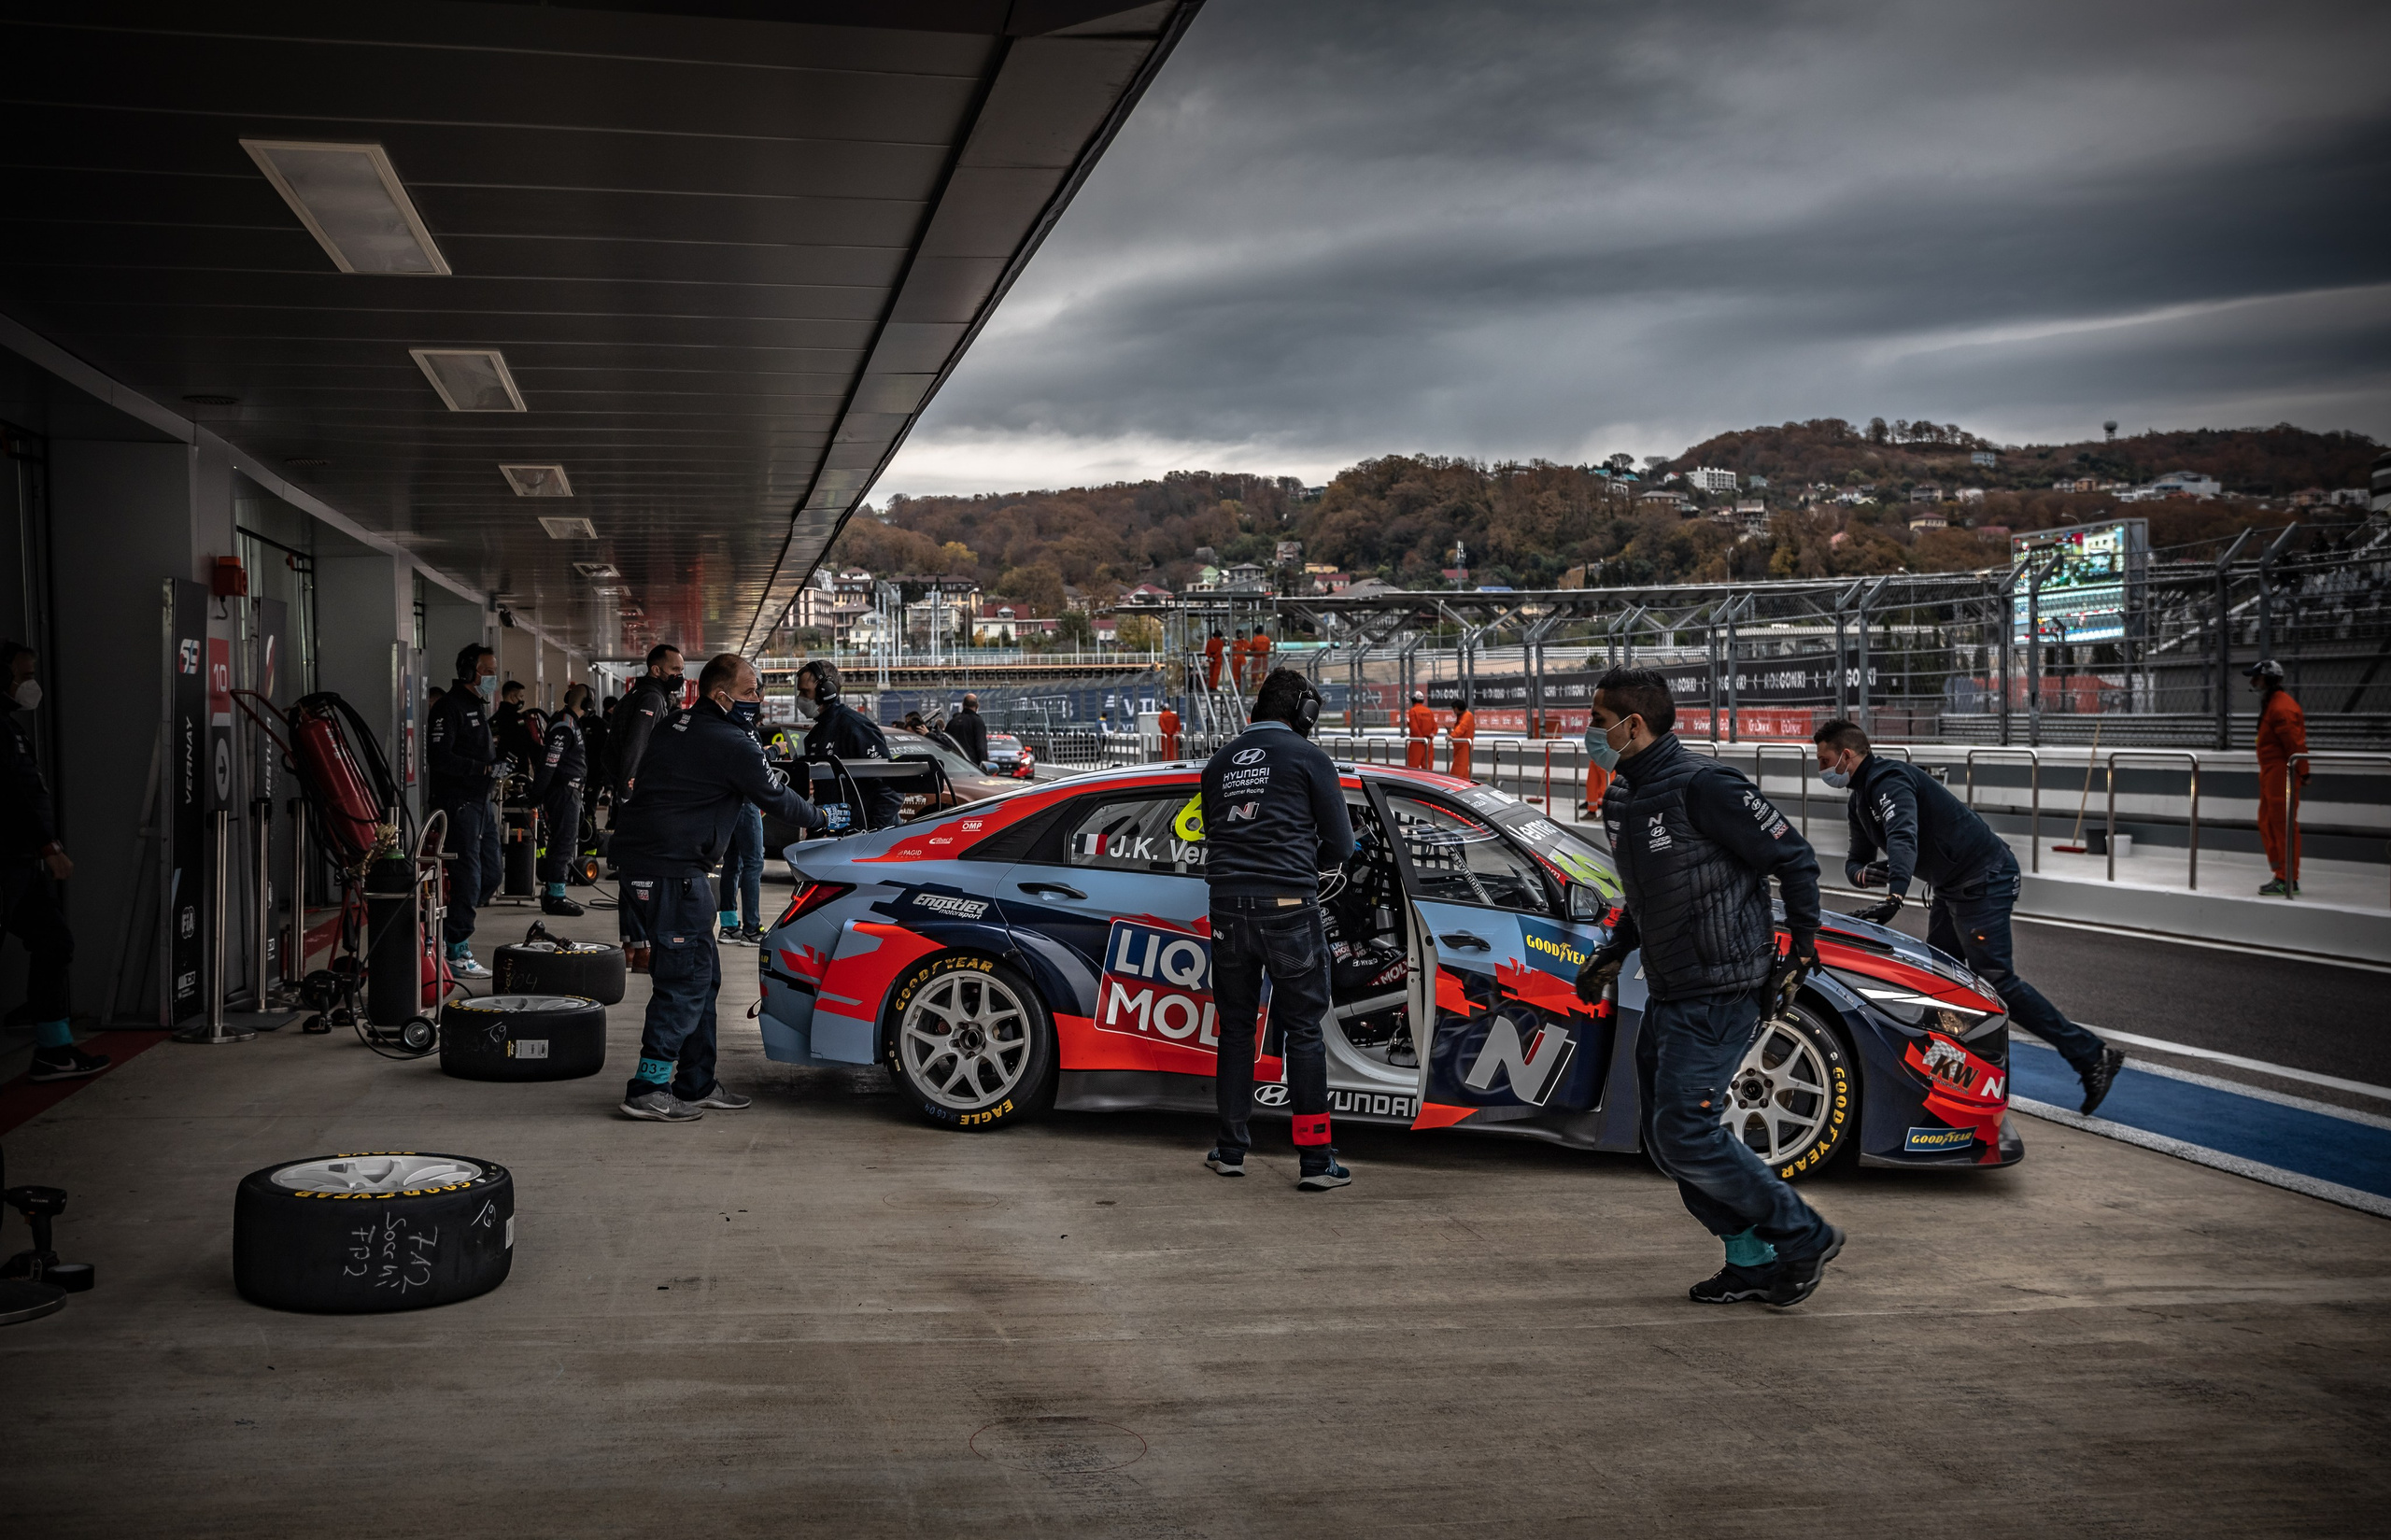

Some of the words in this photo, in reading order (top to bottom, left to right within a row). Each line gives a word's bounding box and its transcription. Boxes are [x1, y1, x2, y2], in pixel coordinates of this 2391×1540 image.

[213, 663, 227, 692] 10
[1223, 777, 1268, 790] MOTORSPORT
[1224, 767, 1270, 783] HYUNDAI
[1224, 789, 1246, 798] Customer
[962, 822, 983, 830] OMP
[1175, 792, 1206, 842] 6
[1110, 835, 1158, 860] J.K.
[1169, 839, 1208, 865] Ver
[1455, 855, 1483, 897] HYUNDAI
[913, 893, 989, 915] Engstler
[938, 908, 982, 920] motorsport
[1114, 928, 1216, 991] LIQ
[1525, 934, 1588, 966] GOODYEA
[895, 956, 994, 1011] GOODYEAR
[1105, 982, 1219, 1047] MOL
[641, 1062, 658, 1074] 03
[1464, 1014, 1577, 1107] N
[1929, 1054, 1980, 1091] KW
[1980, 1075, 2005, 1100] N
[959, 1098, 1014, 1125] EAGLE
[1326, 1091, 1418, 1117] UNDAI
[1781, 1067, 1848, 1180] GOODYEAR
[1914, 1131, 1973, 1147] GOODYEAR
